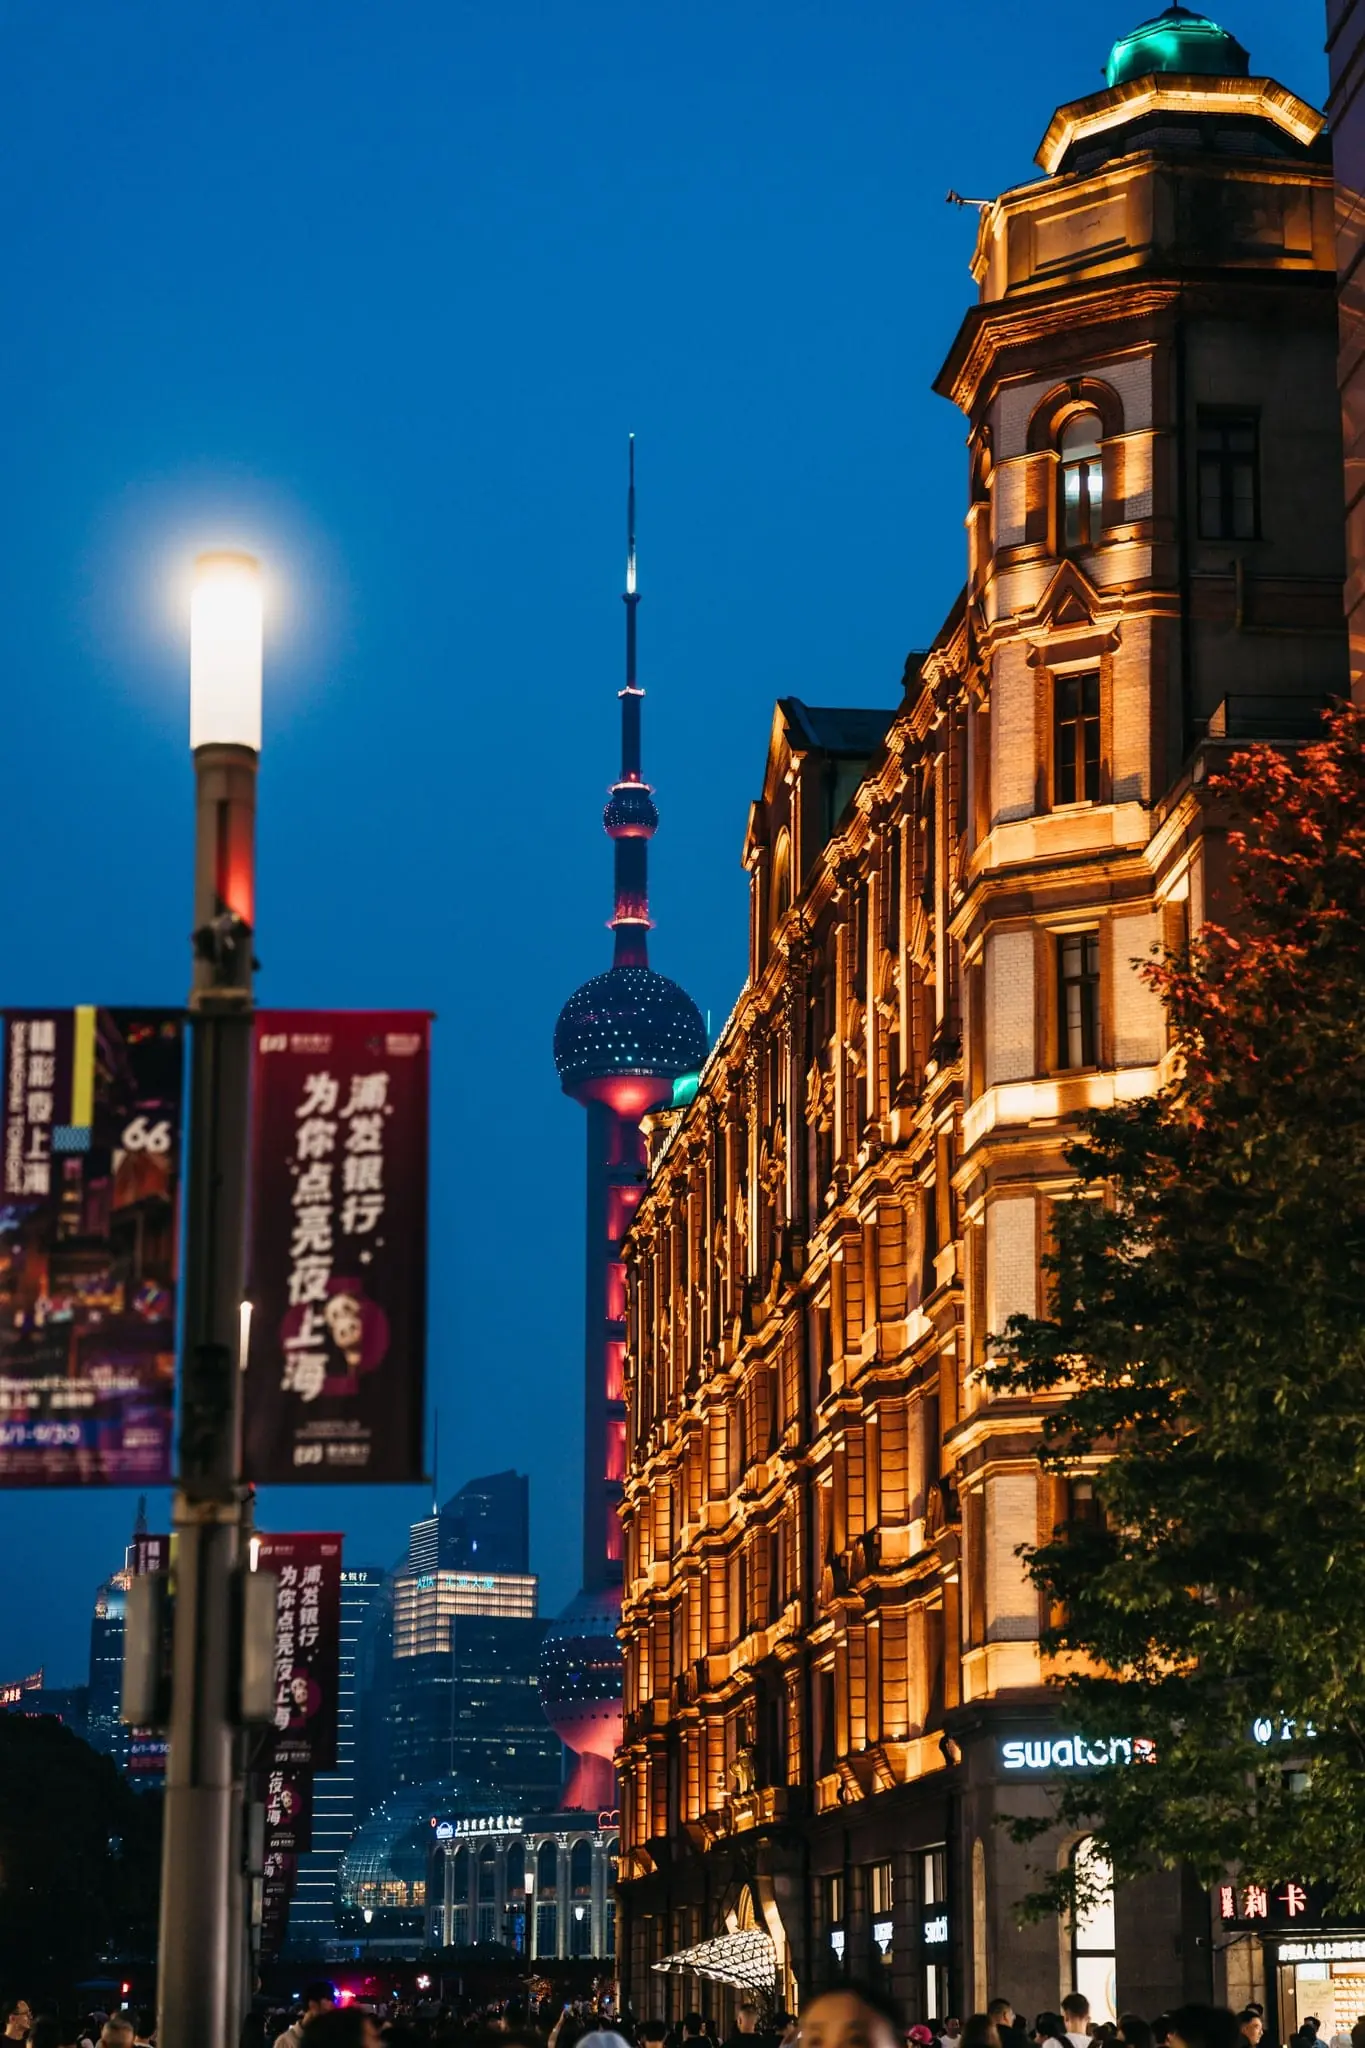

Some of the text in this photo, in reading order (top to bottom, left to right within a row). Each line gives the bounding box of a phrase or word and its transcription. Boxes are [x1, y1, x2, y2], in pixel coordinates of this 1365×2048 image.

[121, 1116, 171, 1153] 66
[339, 1072, 390, 1234] 浦发银行
[281, 1071, 339, 1401] 为你点亮夜上海
[298, 1565, 322, 1647] 浦发银行
